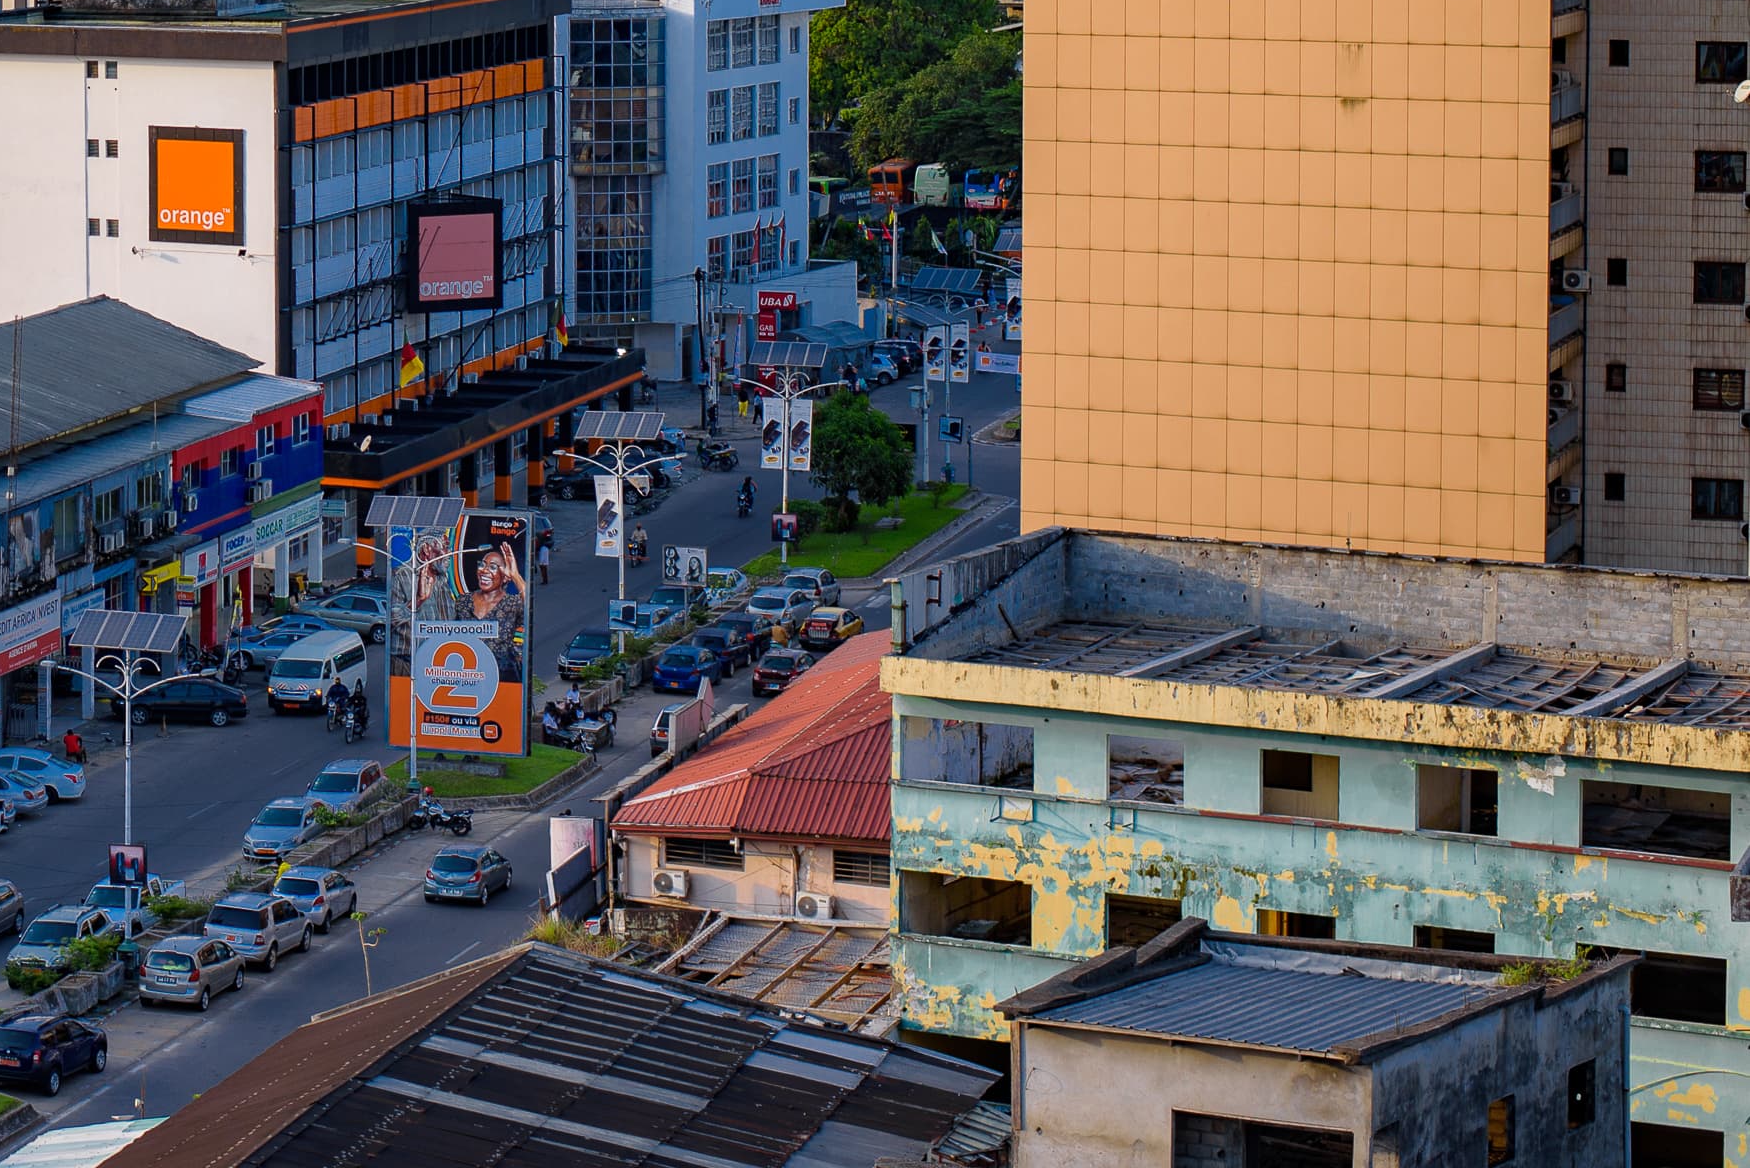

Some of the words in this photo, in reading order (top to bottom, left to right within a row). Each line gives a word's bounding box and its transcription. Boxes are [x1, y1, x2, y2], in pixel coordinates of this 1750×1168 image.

[160, 208, 225, 230] orange
[420, 280, 484, 299] orange
[759, 297, 781, 306] UBA
[12, 608, 36, 628] AFRICA
[36, 598, 59, 619] INVEST
[425, 668, 485, 679] Millionnaires
[430, 641, 478, 709] 2
[431, 677, 460, 686] chaque
[425, 714, 450, 724] #150#
[452, 717, 463, 725] ou
[464, 716, 478, 726] via
